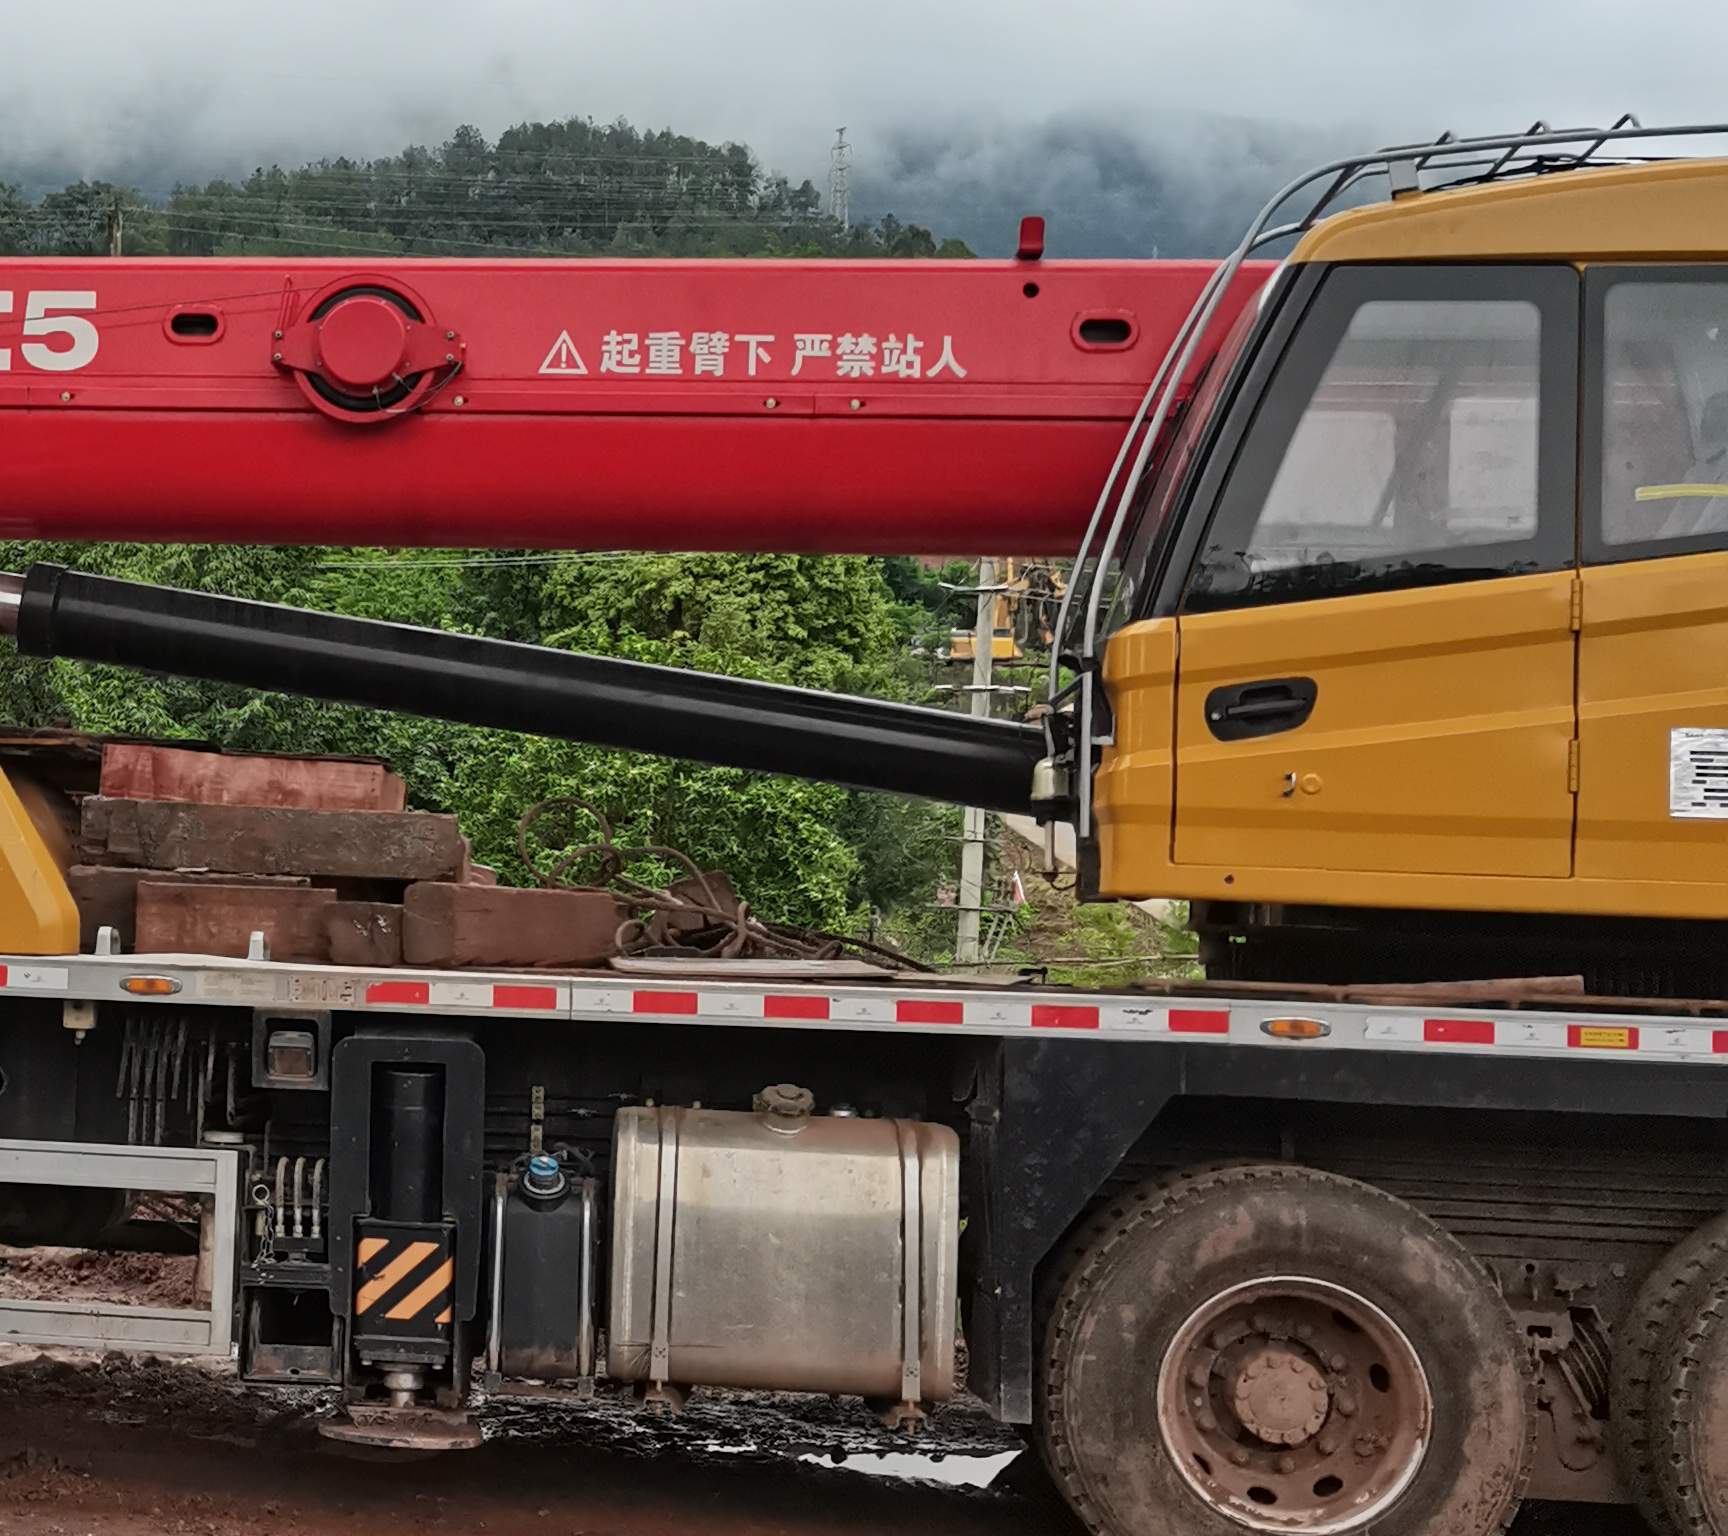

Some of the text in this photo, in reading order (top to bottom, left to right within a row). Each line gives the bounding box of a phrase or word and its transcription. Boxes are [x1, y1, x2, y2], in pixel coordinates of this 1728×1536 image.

[600, 329, 968, 378] 起重臂下 严禁站人
